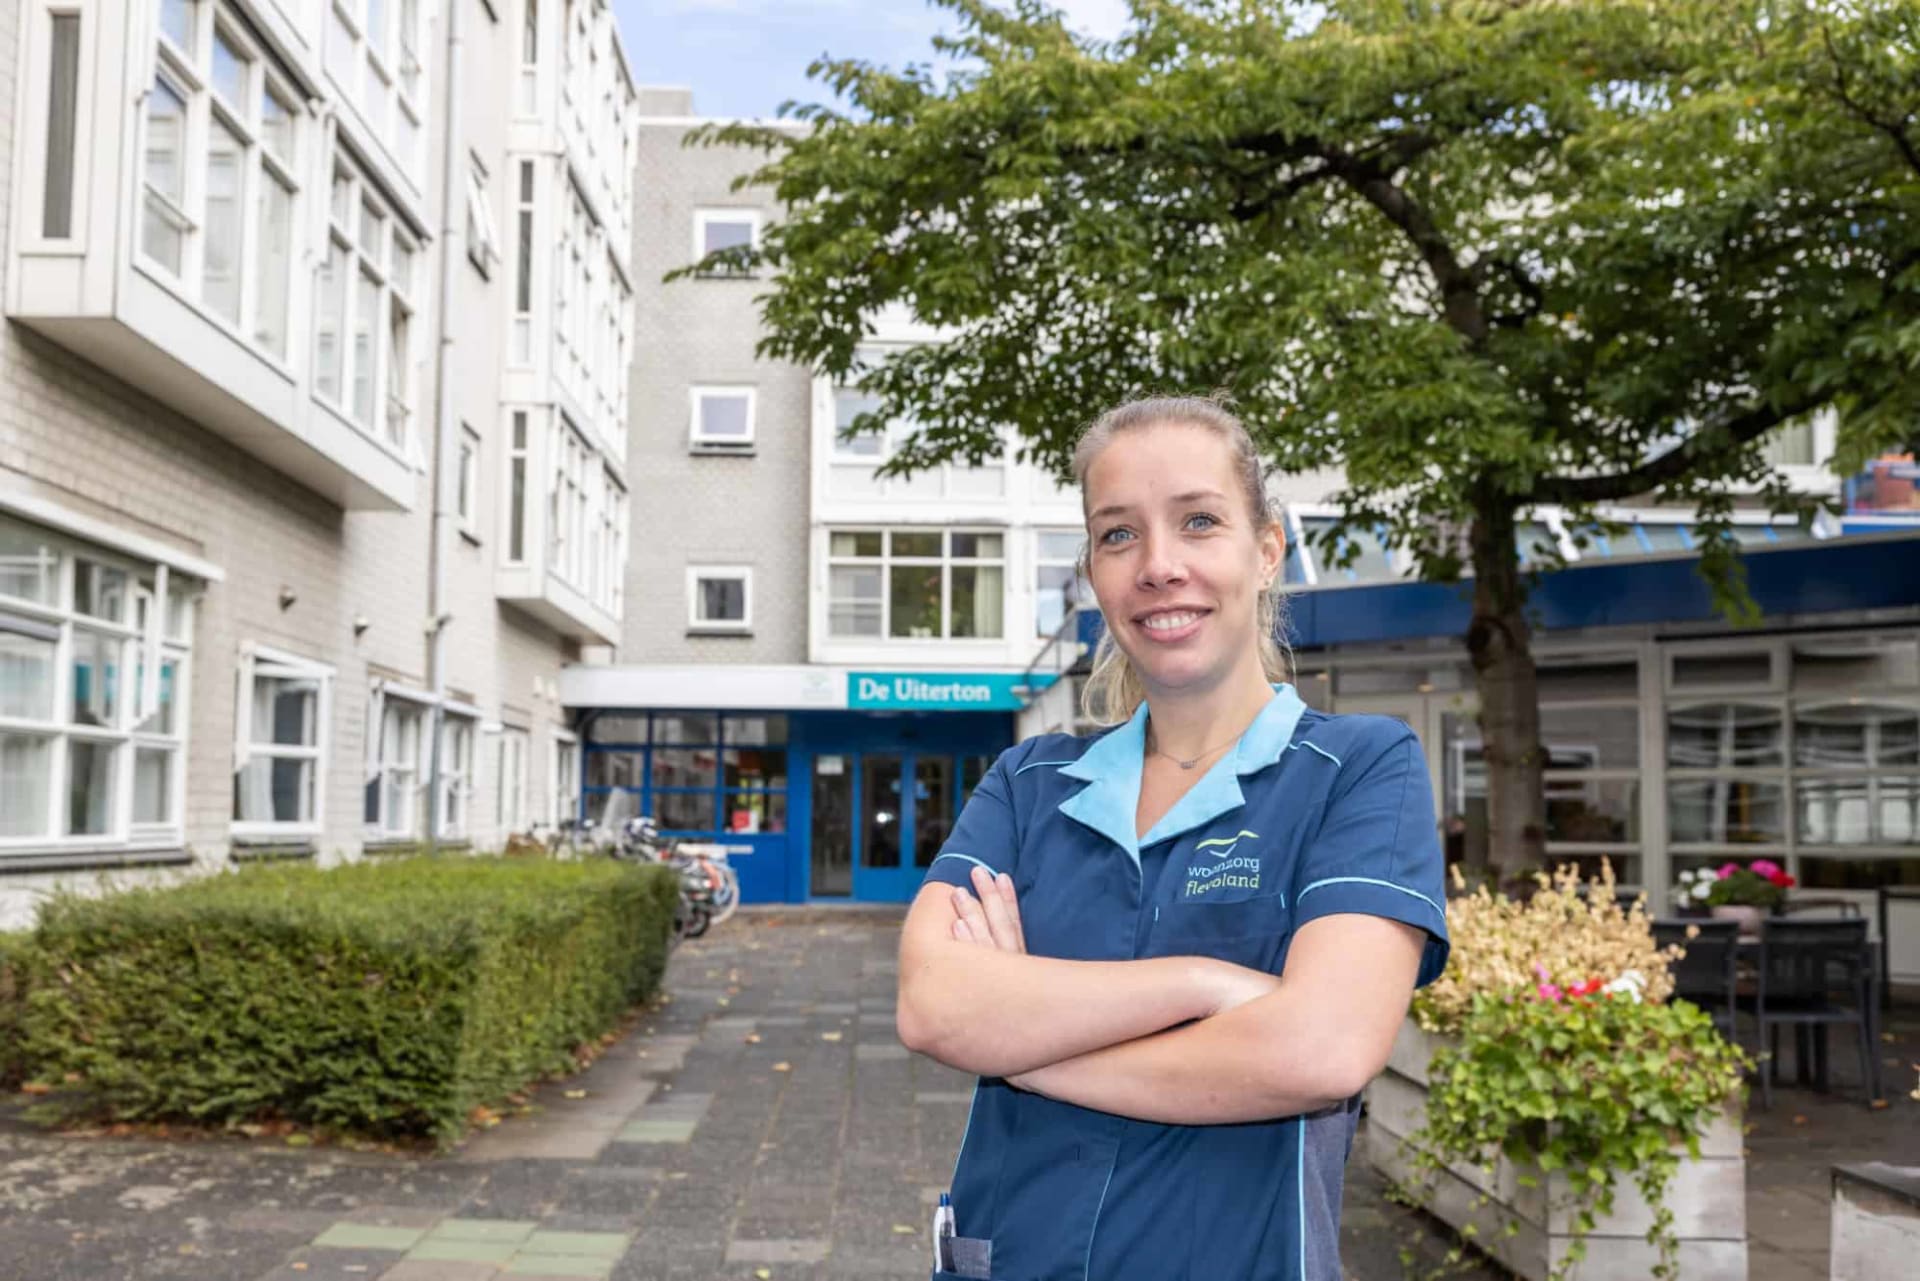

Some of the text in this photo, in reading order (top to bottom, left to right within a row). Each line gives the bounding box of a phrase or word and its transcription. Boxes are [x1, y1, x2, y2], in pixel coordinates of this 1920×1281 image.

[858, 678, 889, 701] De
[894, 678, 990, 702] Uiterton
[1185, 873, 1260, 897] flevoland
